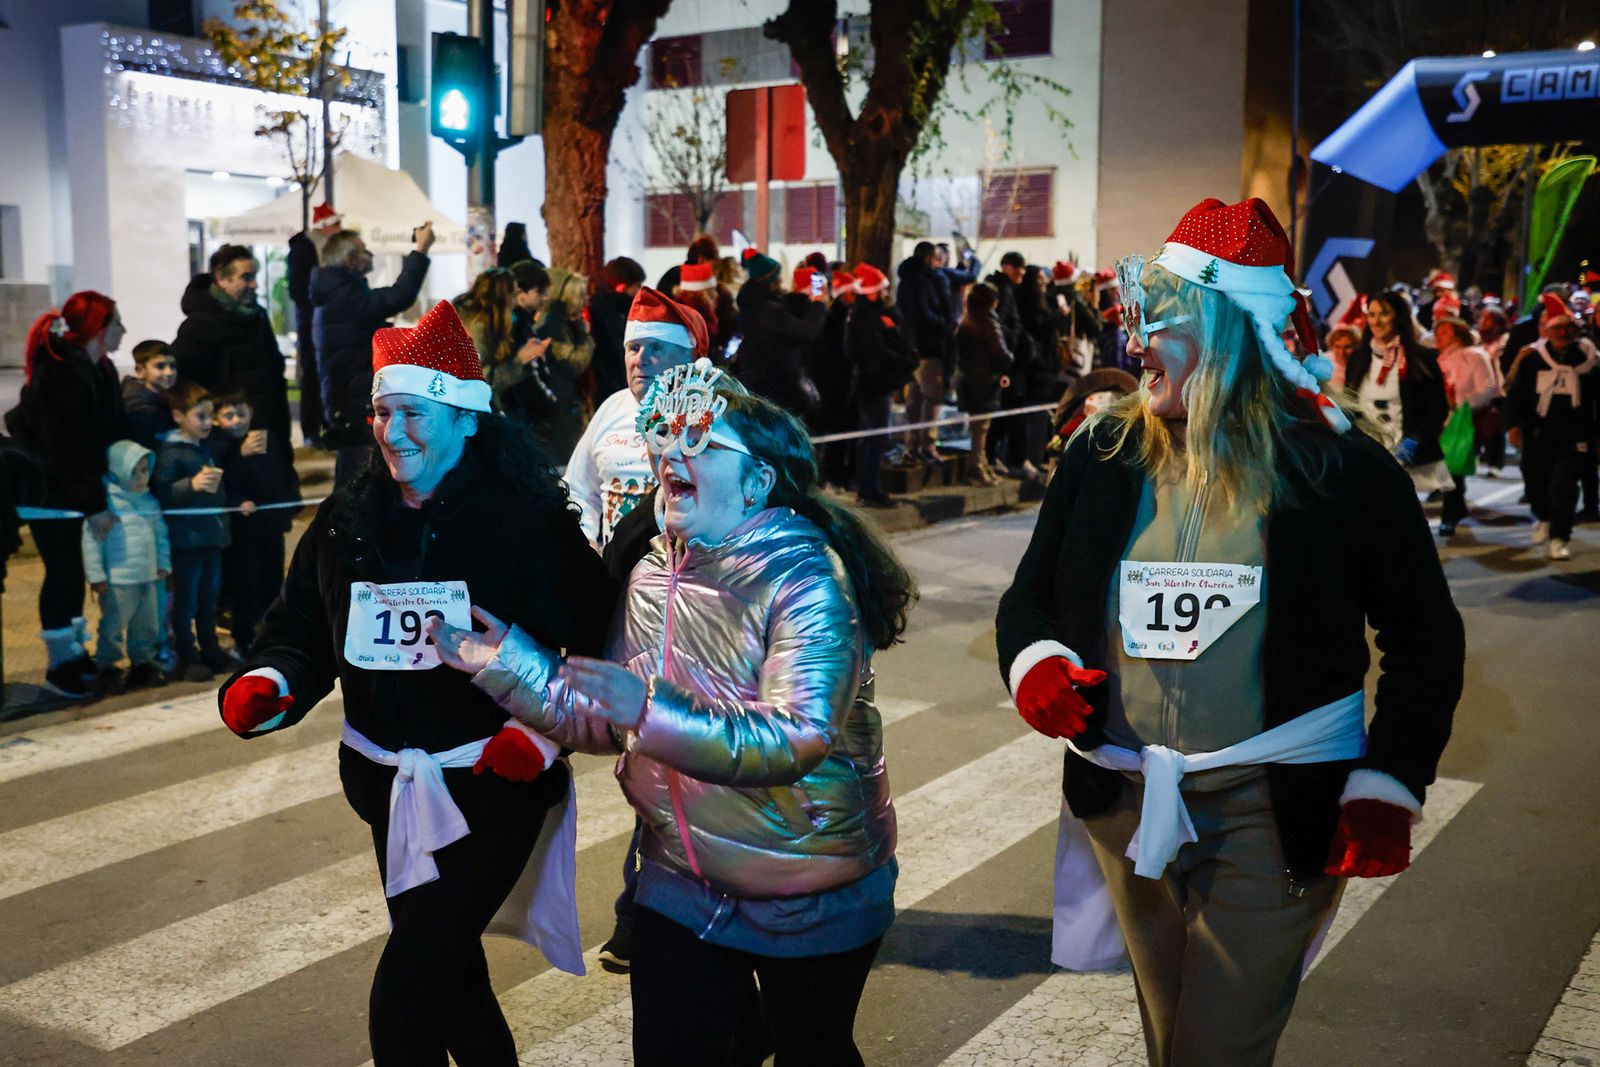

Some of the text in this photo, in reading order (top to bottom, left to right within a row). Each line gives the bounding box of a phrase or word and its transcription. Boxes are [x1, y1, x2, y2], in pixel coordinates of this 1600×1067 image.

[1148, 567, 1233, 578] CARRERA SOLIDARIA
[1145, 578, 1160, 588] San
[1163, 578, 1196, 588] Silvestre
[408, 587, 446, 596] SOLIDARIA
